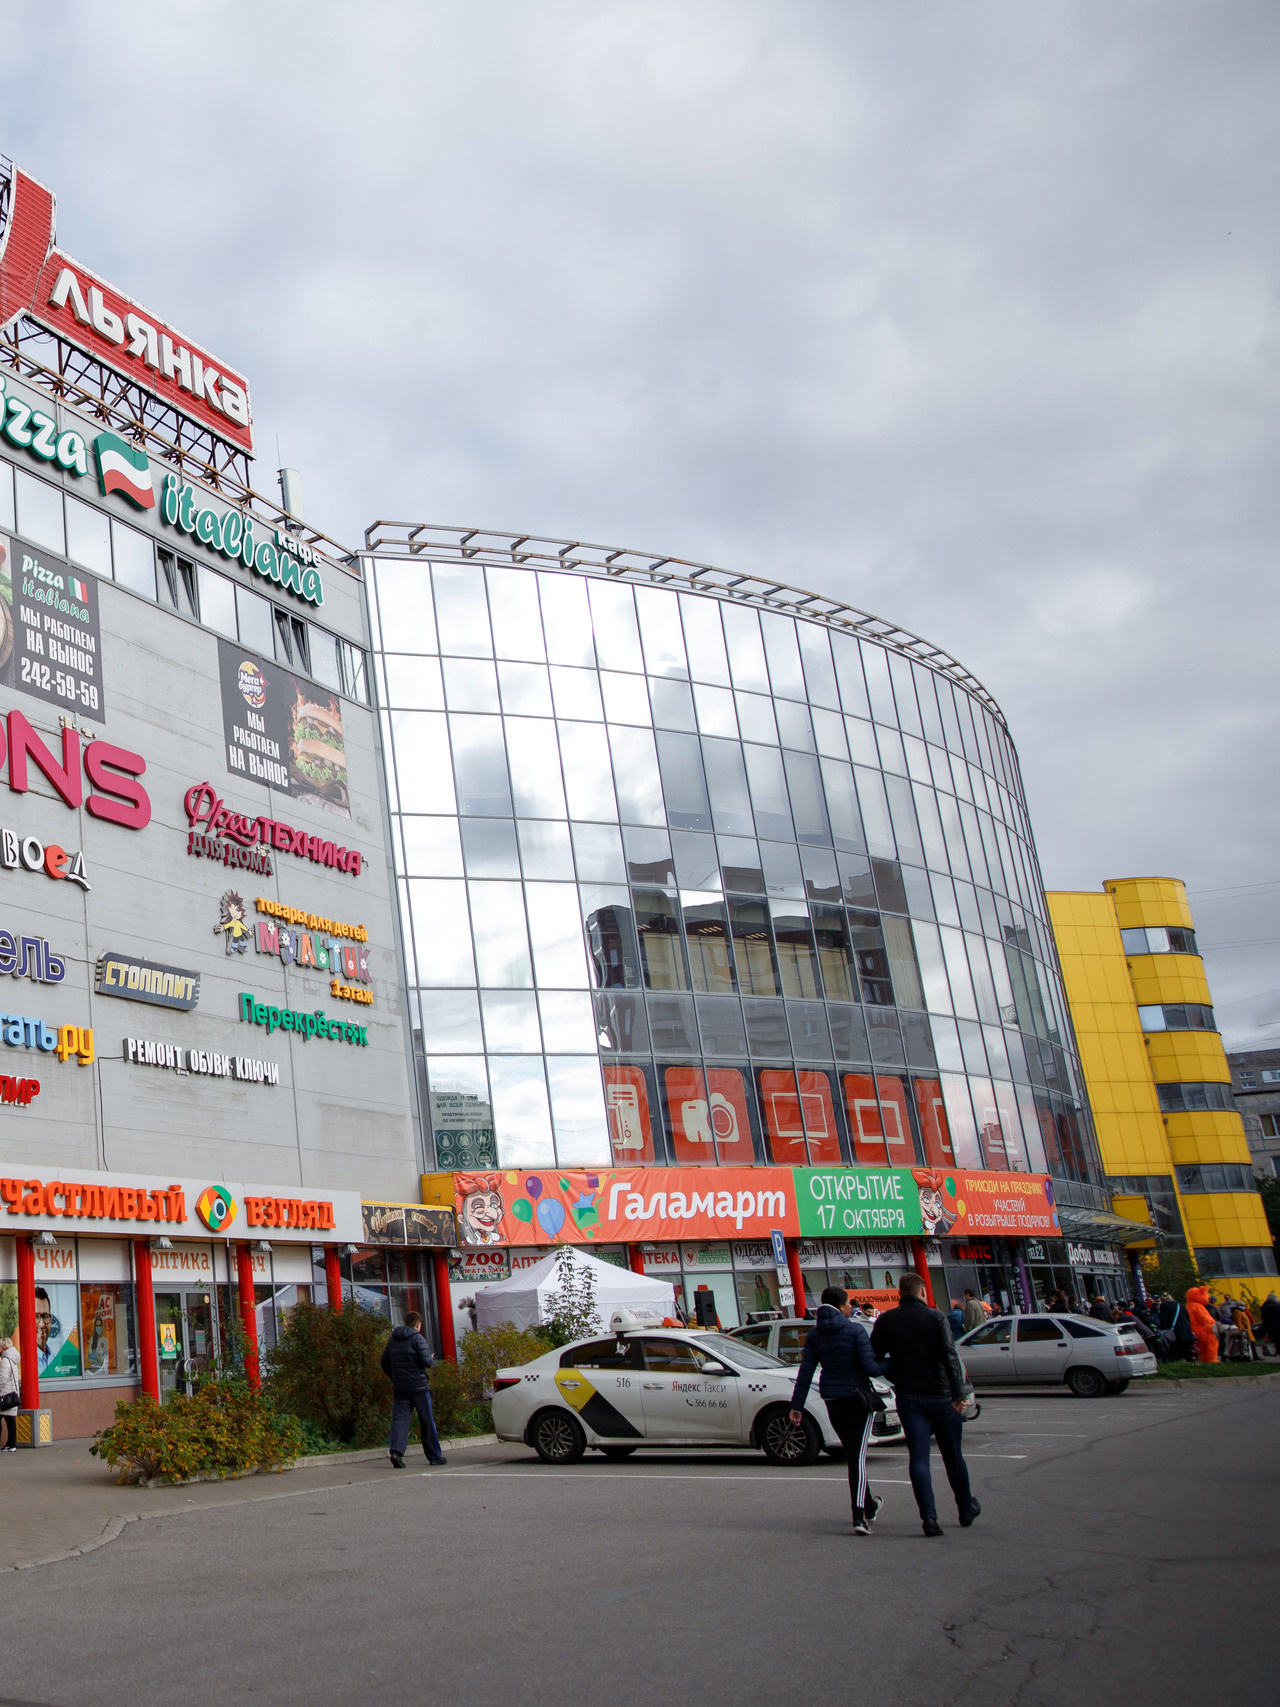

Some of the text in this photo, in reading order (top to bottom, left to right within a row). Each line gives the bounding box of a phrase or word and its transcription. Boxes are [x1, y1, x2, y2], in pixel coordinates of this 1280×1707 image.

[161, 472, 325, 607] italiana
[22, 554, 65, 590] Pizza
[22, 577, 90, 623] italiana
[20, 604, 96, 653] МЫ РАБОТАЕМ
[26, 628, 94, 676] НА ВЫНОС
[21, 656, 99, 710] 242-59-59
[246, 710, 266, 733] МЫ
[233, 724, 280, 760] РАБОТАЕМ
[229, 744, 289, 788] НА ВЫНОС
[188, 831, 275, 877] ДЛЯ ДОМА
[255, 896, 369, 942] товары для детей
[104, 960, 196, 1001] СТОЛПЛИТ
[122, 1037, 183, 1069] РЕМОНТ
[232, 1056, 280, 1085] КЛЮЧИ
[809, 1174, 905, 1201] ОТКРЫТИЕ
[965, 1179, 999, 1194] ПРИХОДИ
[1000, 1179, 1011, 1194] НА
[607, 1181, 787, 1230] Галамарт
[816, 1204, 906, 1230] 17 ОКТЯБРЯ
[992, 1197, 1027, 1213] УЧАСТВУЙ
[967, 1213, 1051, 1229] В РОЗЫГРЫШЕ ПОДАРКОВ!
[464, 1252, 505, 1267] ZOO
[642, 1252, 680, 1265] ТЕКА
[734, 1243, 776, 1259] ОДЕЖДА
[827, 1242, 864, 1257] ОДЕЖДА
[869, 1240, 903, 1255] ОДЕЖДА
[966, 1245, 992, 1260] МТС
[1067, 1242, 1092, 1266] Добро
[464, 1267, 506, 1275] МАГАЗИН
[698, 1256, 731, 1265] ЗДОРОВЬЯ
[615, 1377, 632, 1389] 516
[671, 1380, 727, 1394] Яндекс Такси
[694, 1398, 728, 1409] 366 66 66
